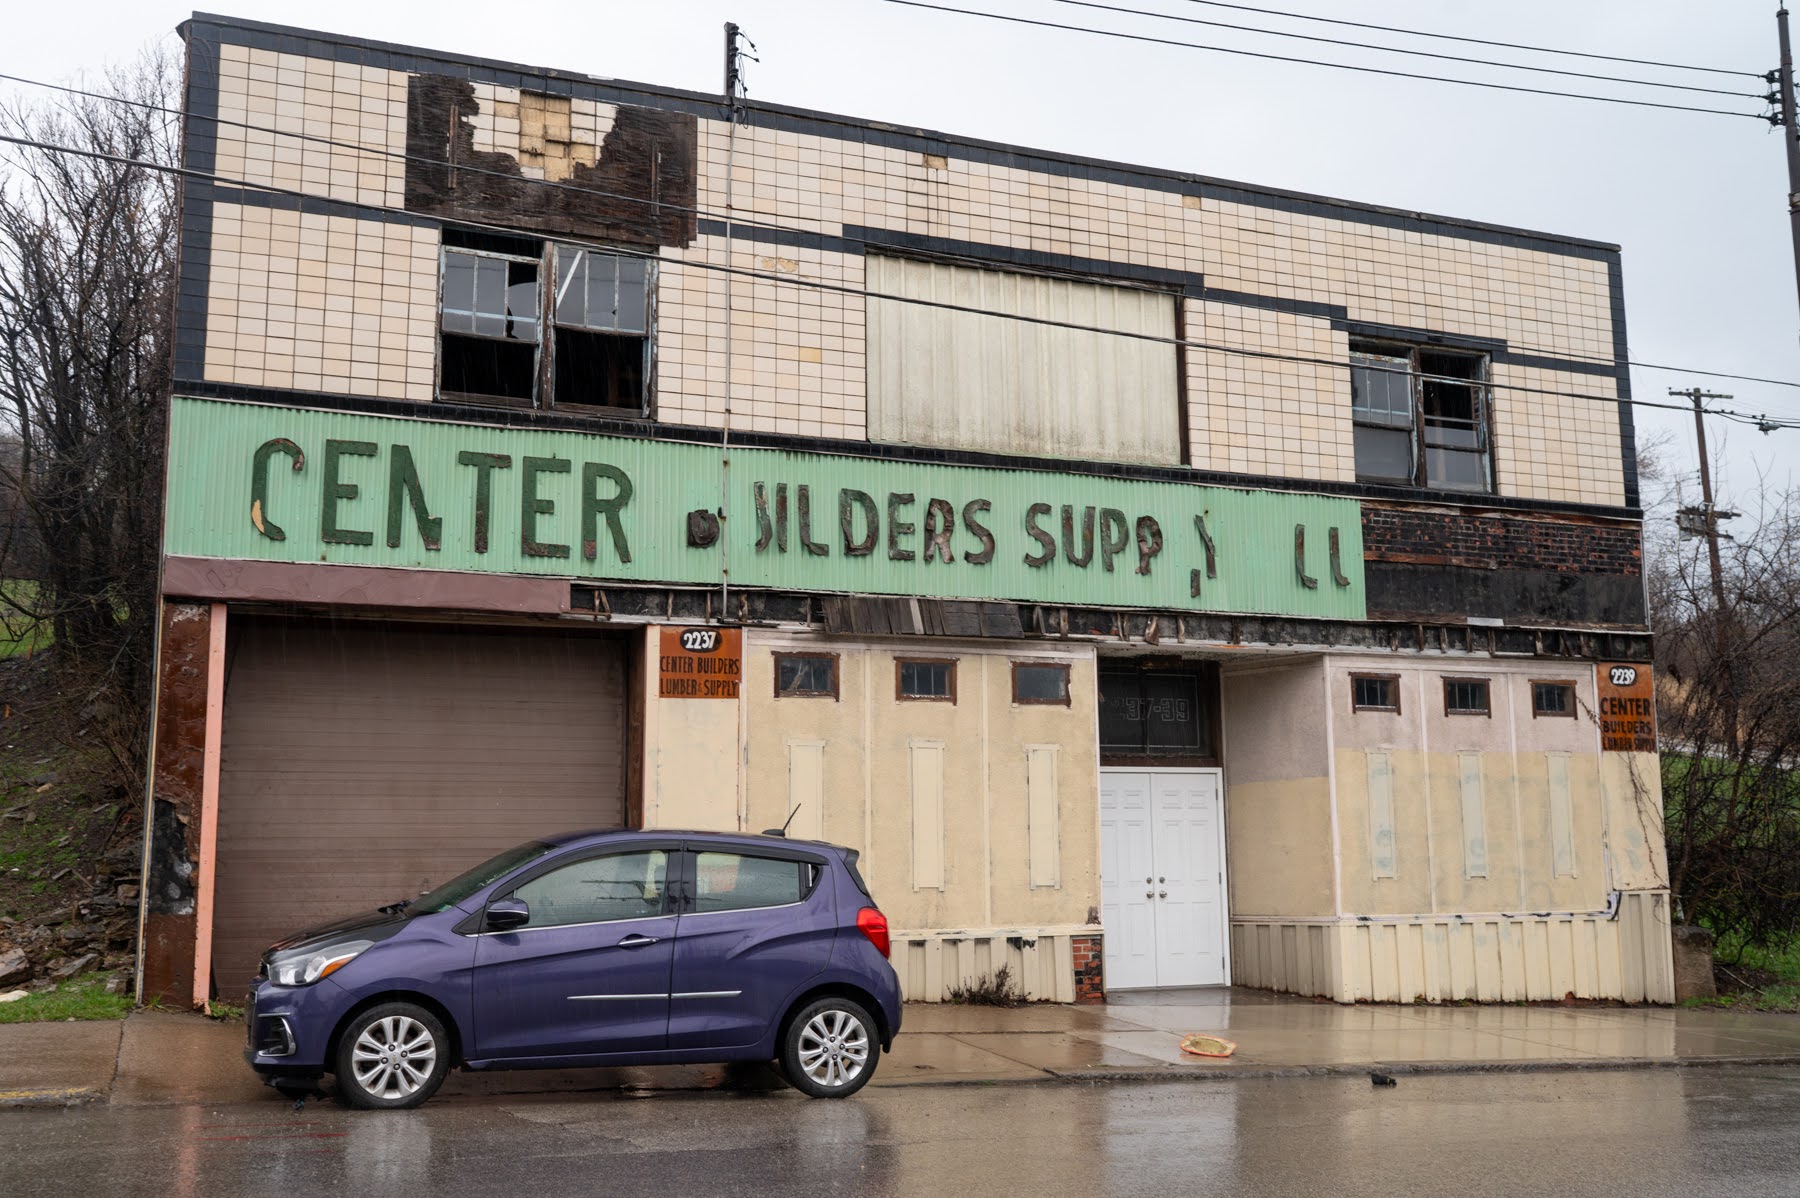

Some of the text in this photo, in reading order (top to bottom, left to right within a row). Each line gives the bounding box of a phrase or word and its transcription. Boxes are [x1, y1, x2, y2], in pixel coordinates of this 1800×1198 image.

[251, 437, 633, 562] CENTER
[1024, 503, 1217, 597] SUPPY
[683, 631, 717, 649] 2237
[660, 656, 740, 675] CENTER BUILDERS
[1611, 668, 1636, 684] 2239
[660, 679, 697, 695] LUMBER
[704, 679, 738, 696] SUPPLY
[1600, 697, 1651, 717] CENTER
[1602, 720, 1652, 735] BUILDERS
